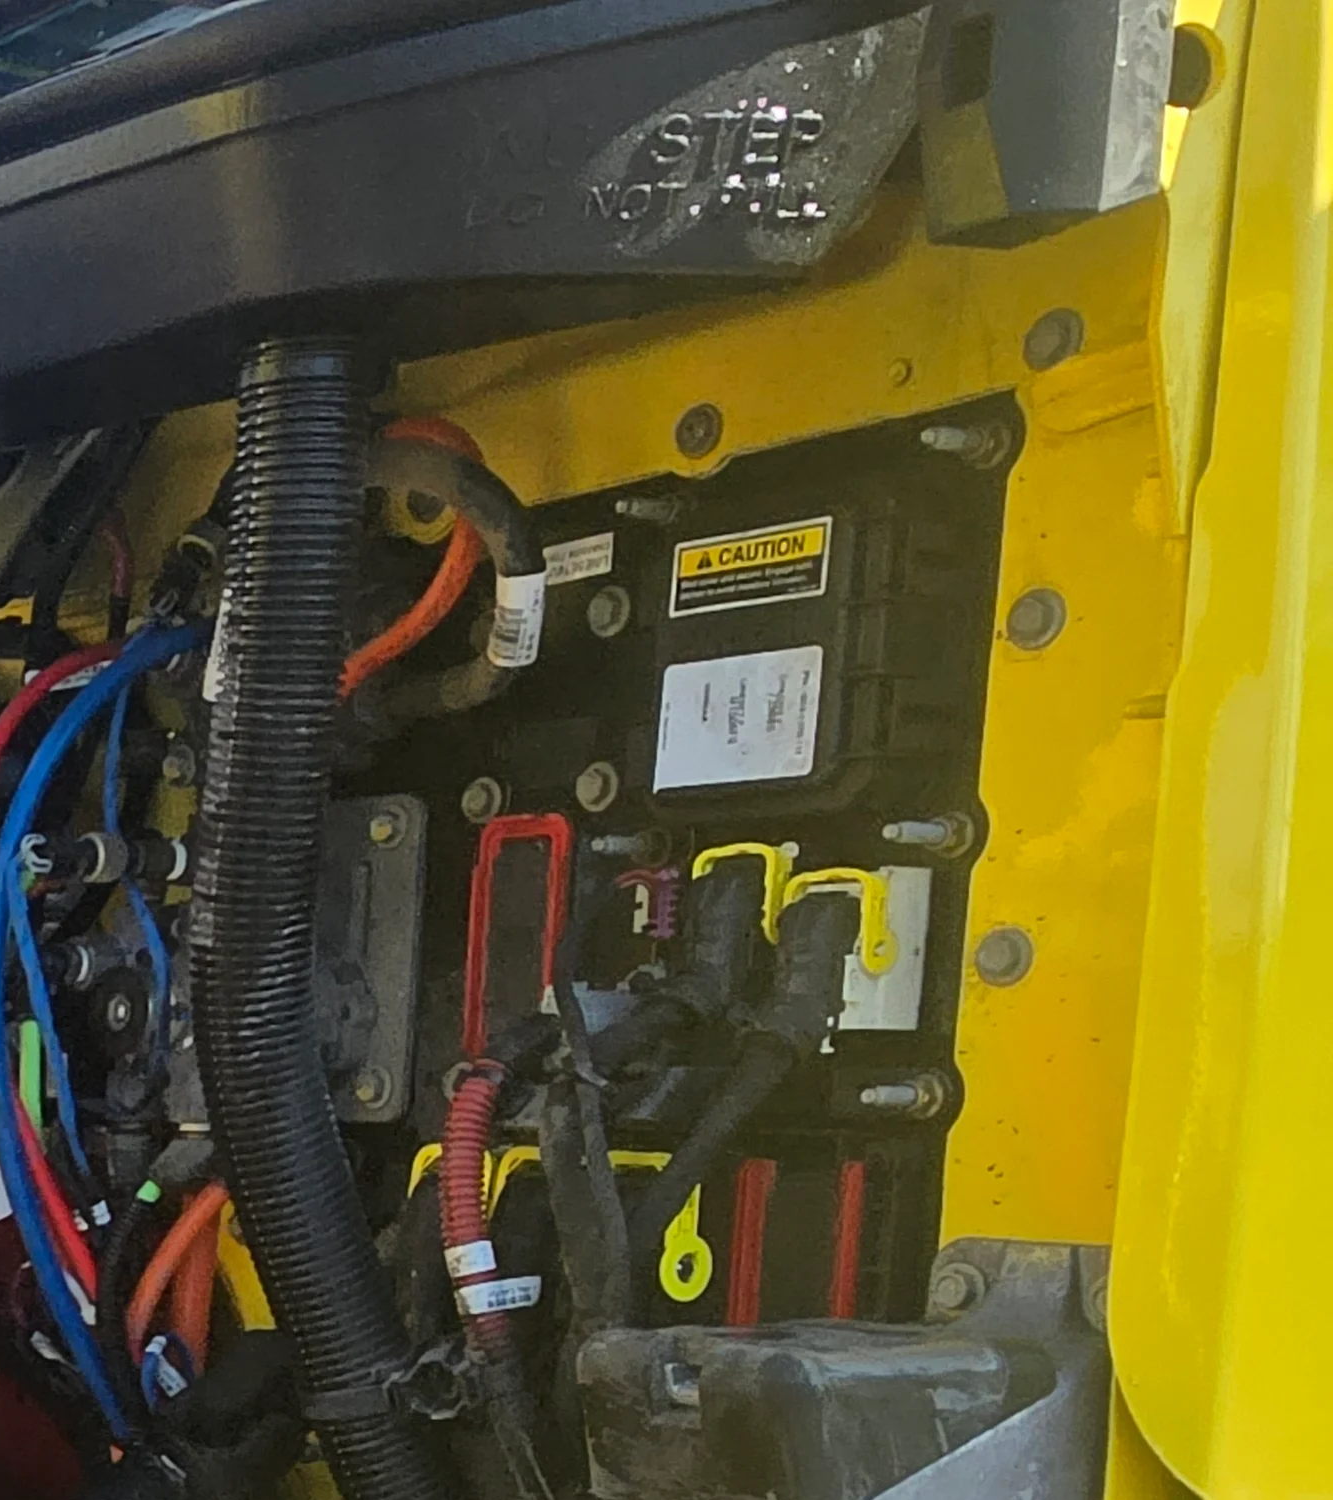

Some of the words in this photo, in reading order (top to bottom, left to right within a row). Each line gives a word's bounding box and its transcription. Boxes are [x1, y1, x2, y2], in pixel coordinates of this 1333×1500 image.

[650, 108, 826, 166] STEP
[583, 182, 688, 220] NOT
[718, 534, 806, 566] CAUTION
